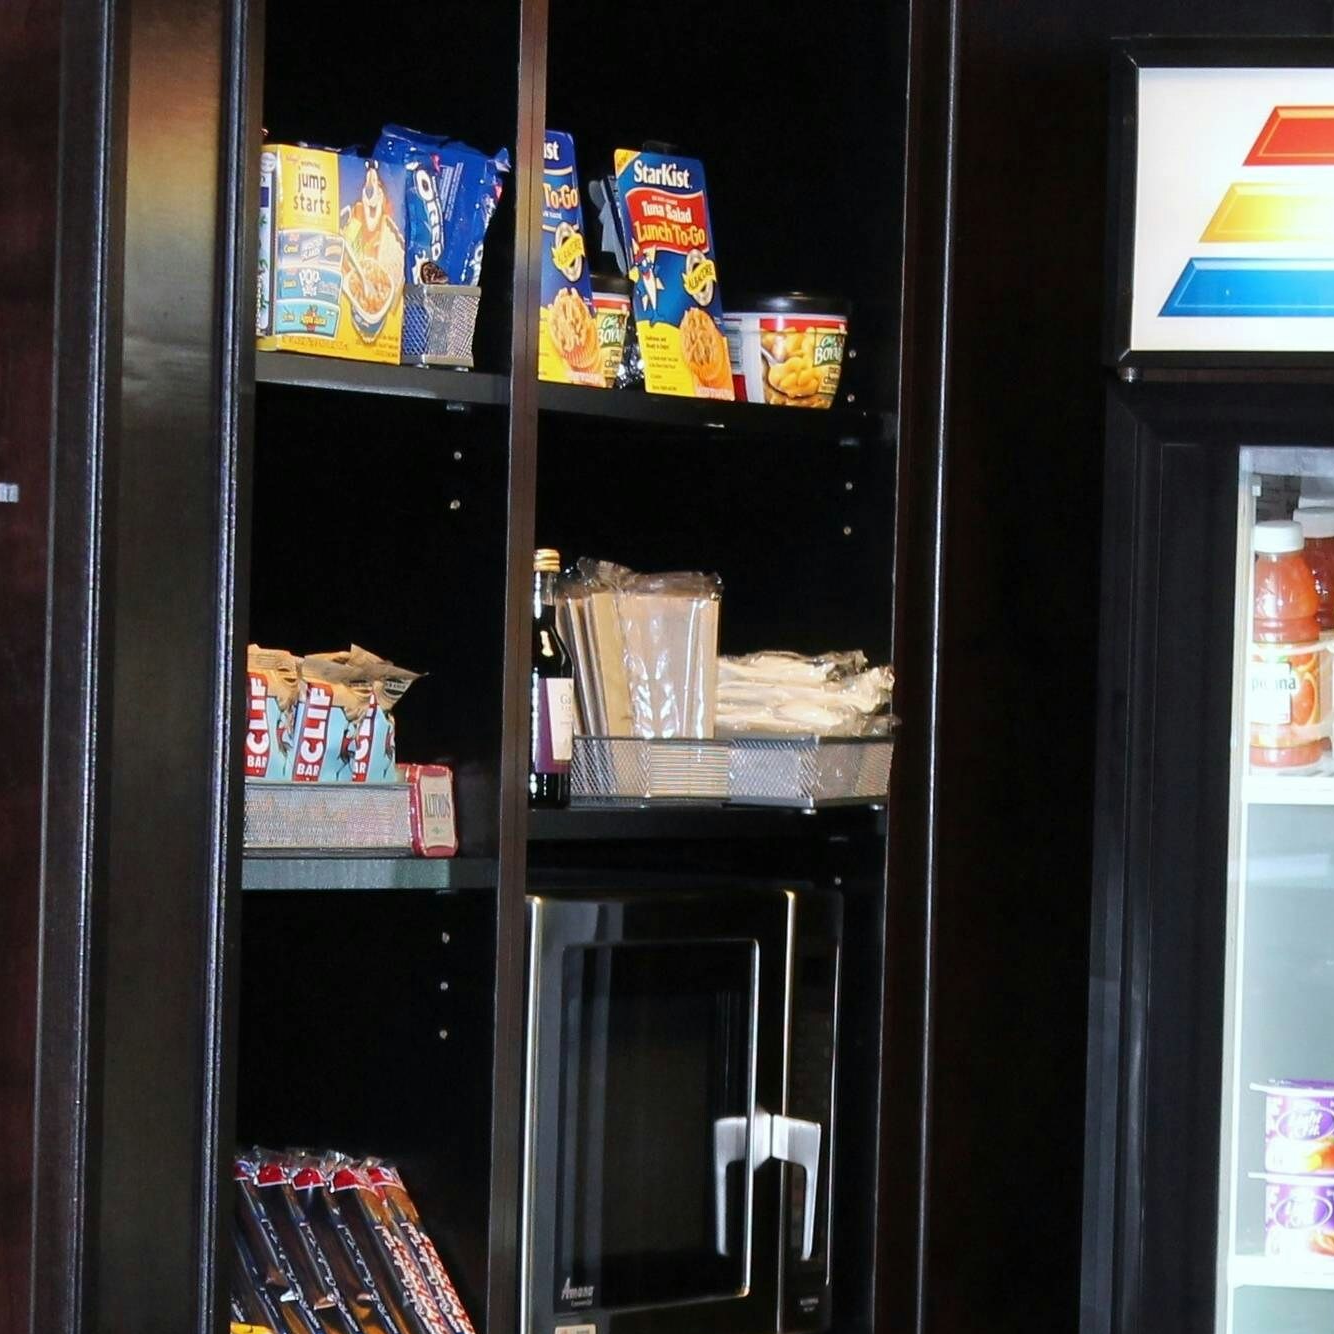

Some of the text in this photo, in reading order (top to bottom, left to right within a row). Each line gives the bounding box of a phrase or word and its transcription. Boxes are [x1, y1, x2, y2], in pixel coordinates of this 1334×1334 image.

[298, 167, 327, 192] jump
[634, 159, 690, 188] StarKist
[293, 194, 331, 215] starts
[415, 169, 442, 261] OREO
[641, 200, 665, 217] Tuna
[665, 202, 693, 224] Salad
[633, 221, 673, 244] Lunch
[246, 677, 270, 754] CLIF
[300, 686, 332, 763] CLIF
[247, 755, 268, 768] BAR
[296, 762, 320, 776] BAR
[354, 765, 367, 774] AR
